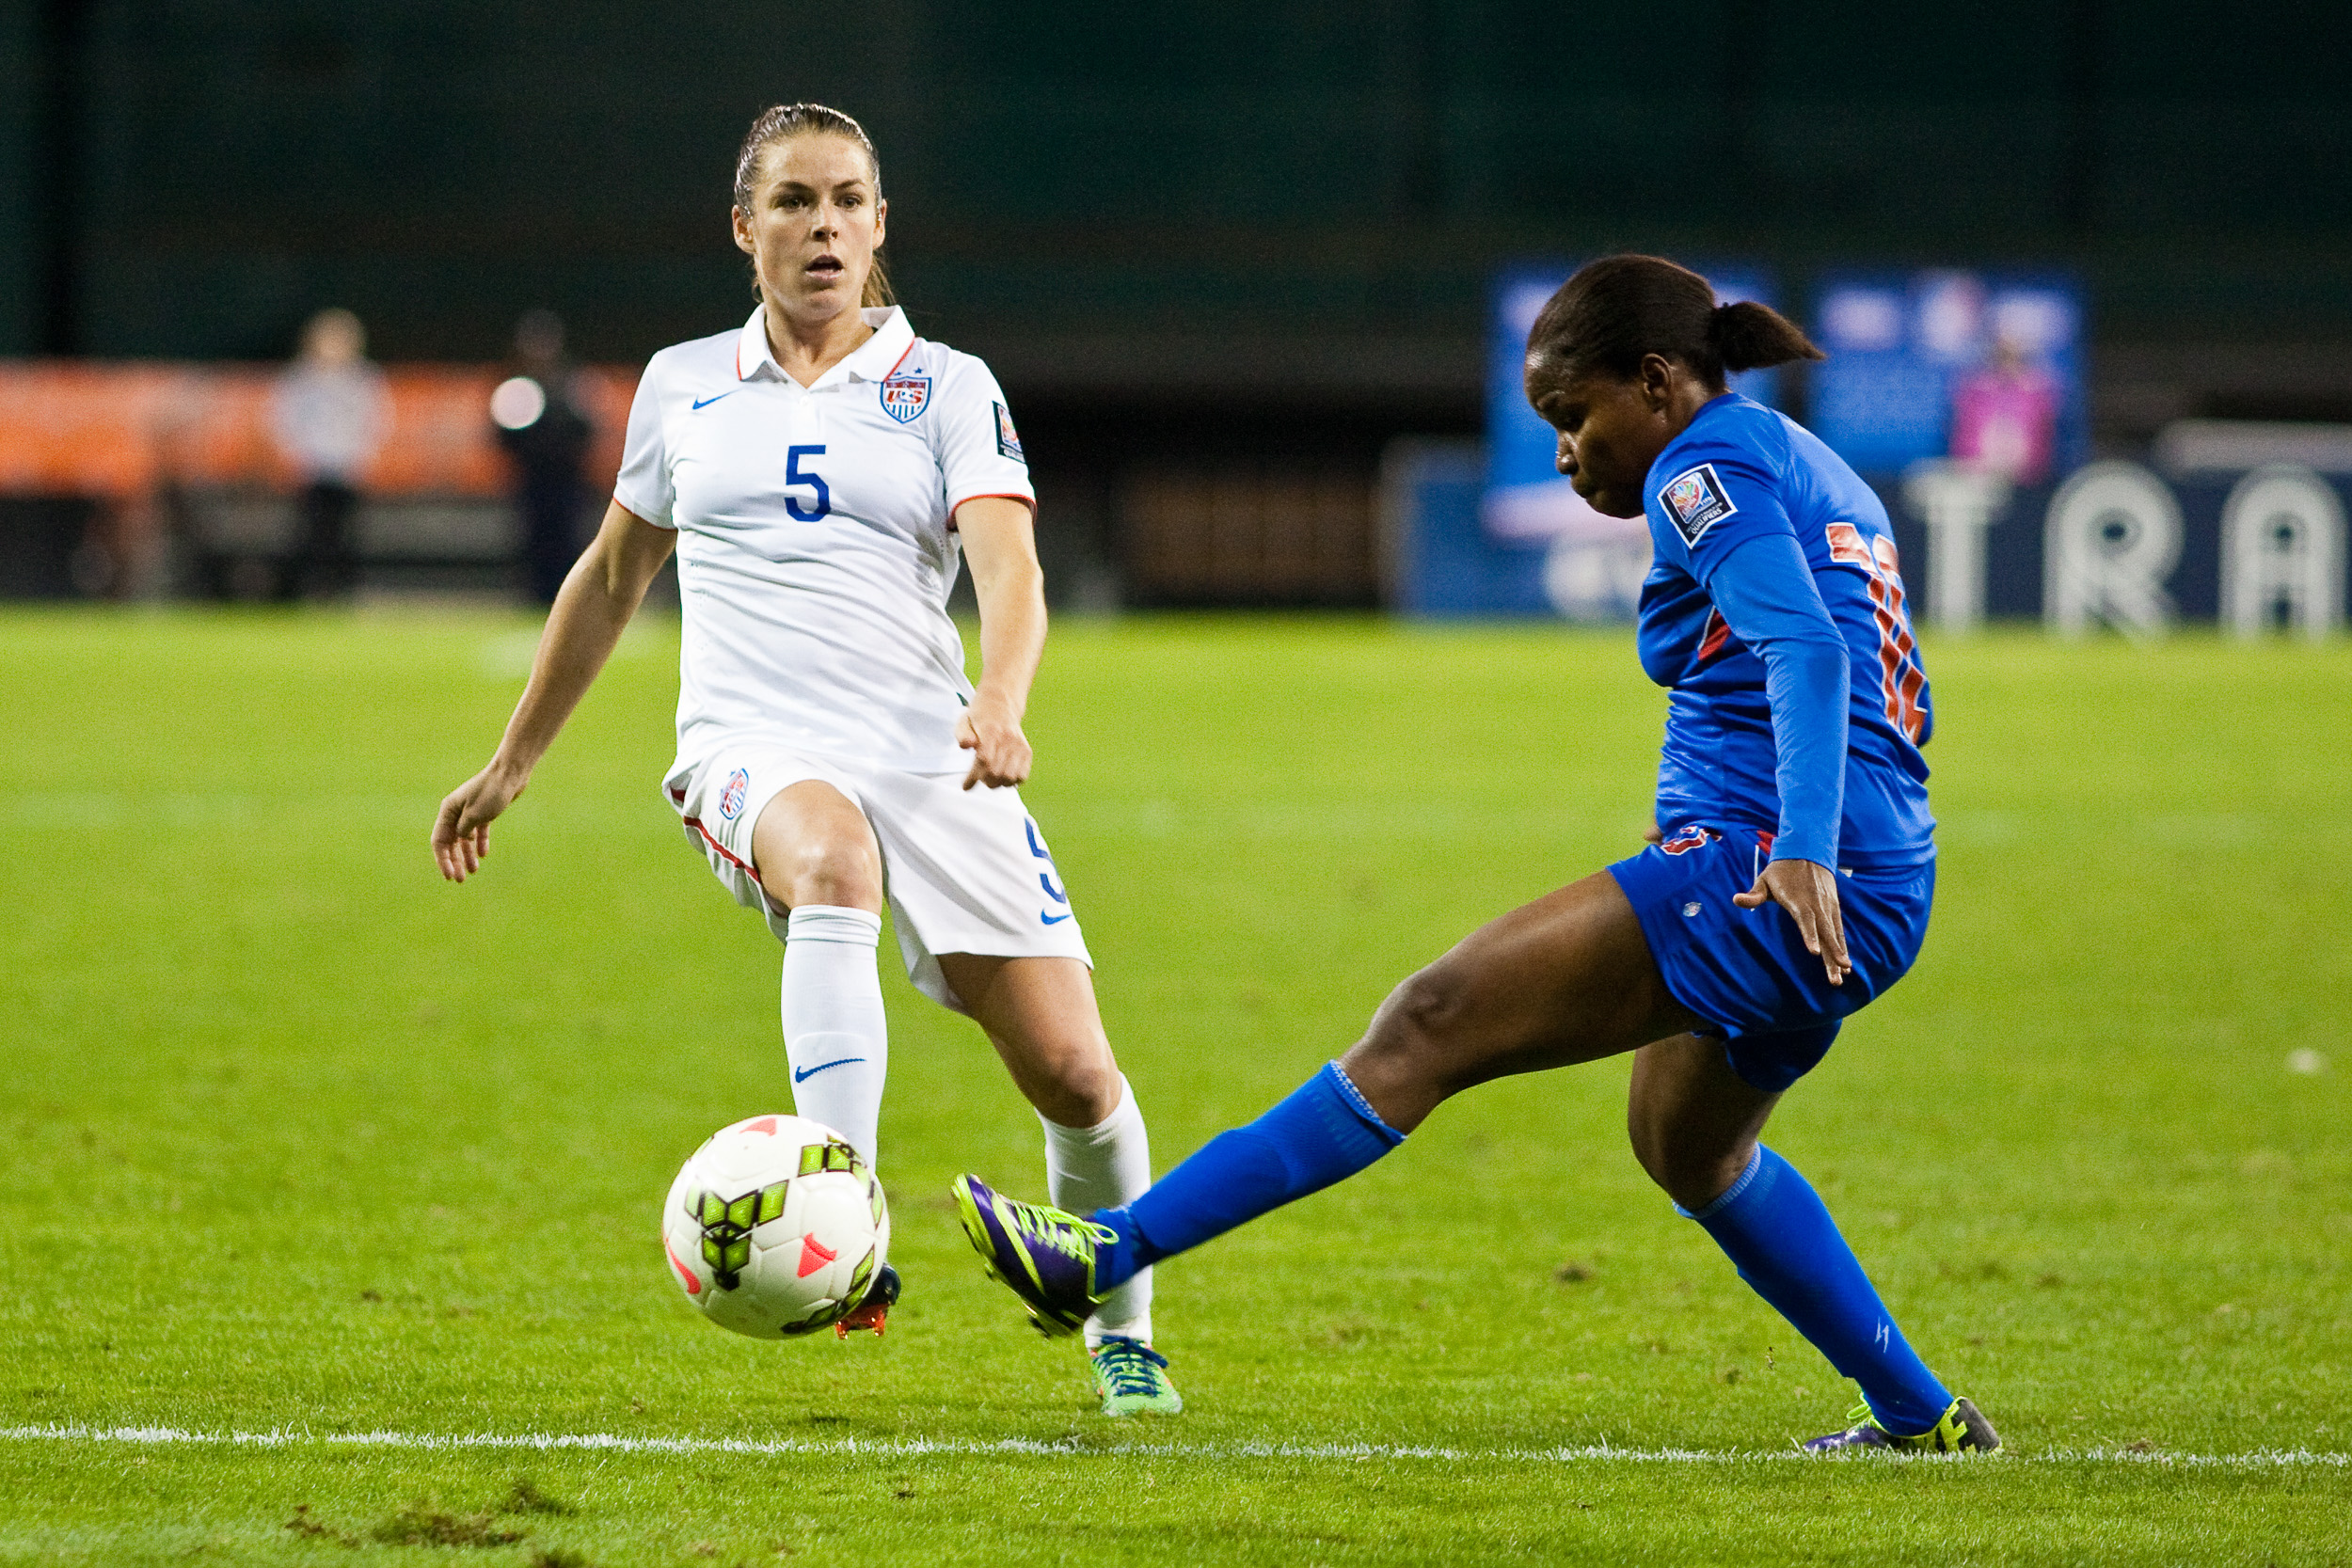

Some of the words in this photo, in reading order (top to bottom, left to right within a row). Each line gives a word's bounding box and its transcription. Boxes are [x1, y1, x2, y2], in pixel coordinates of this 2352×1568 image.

[784, 444, 832, 523] 5
[1691, 508, 1723, 535] QUALIFIERS
[1024, 816, 1067, 904] 5
